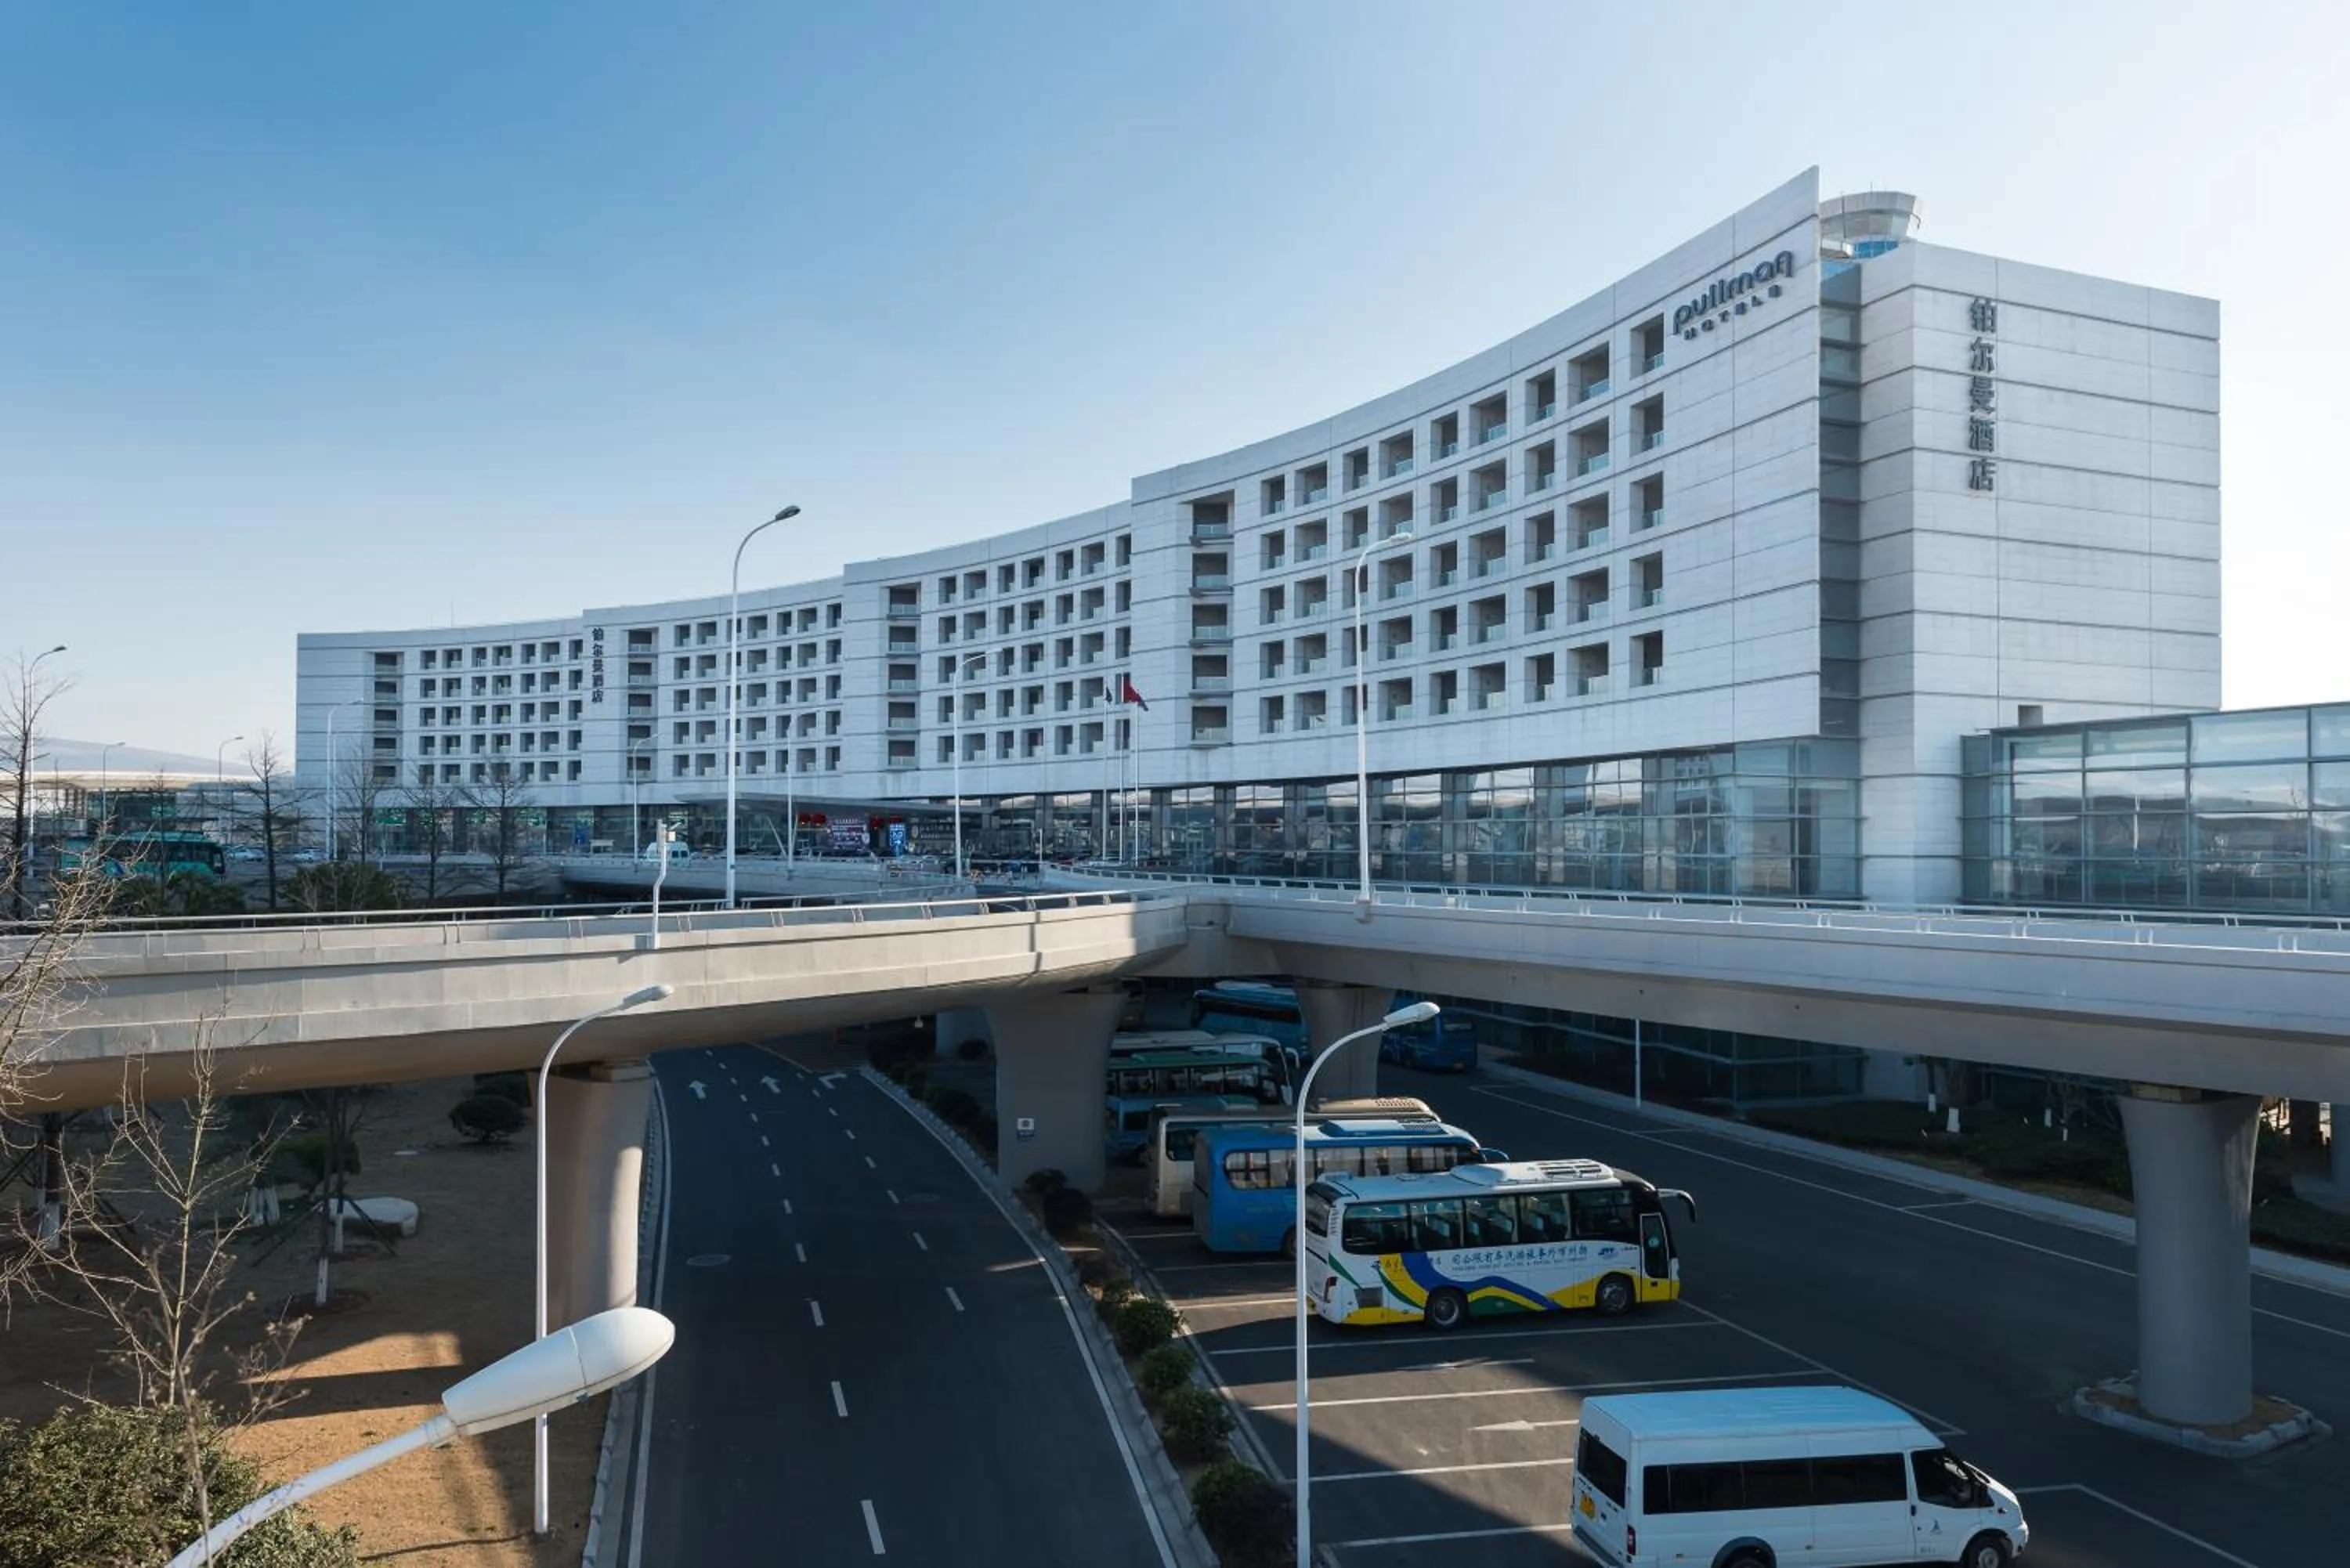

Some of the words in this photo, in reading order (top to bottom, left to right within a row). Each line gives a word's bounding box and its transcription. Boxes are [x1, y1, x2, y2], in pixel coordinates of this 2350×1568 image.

[1672, 250, 1794, 335] pullman
[1969, 295, 1997, 491] 铂尔曼酒店
